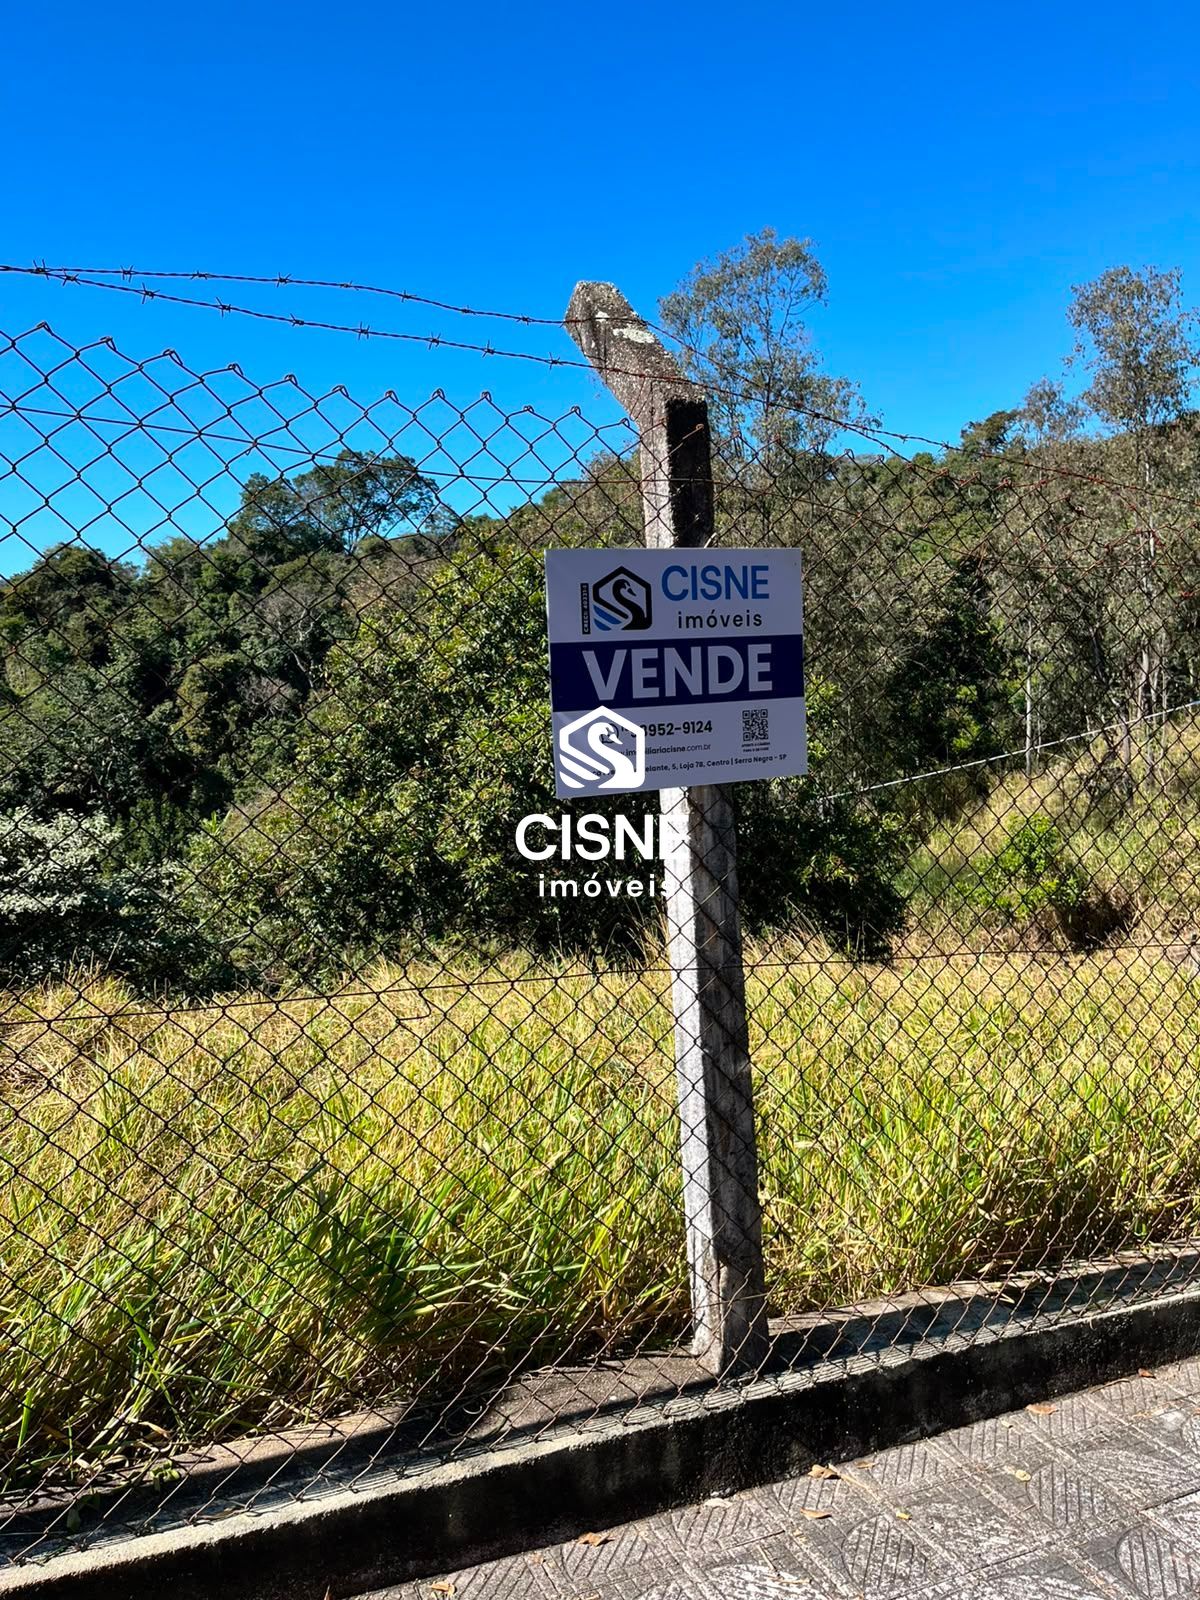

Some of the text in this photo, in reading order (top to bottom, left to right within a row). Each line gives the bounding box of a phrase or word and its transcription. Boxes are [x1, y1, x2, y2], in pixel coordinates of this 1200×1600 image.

[661, 565, 769, 601] CISNE
[678, 609, 763, 629] imóveis
[582, 643, 773, 701] VENDE
[679, 762, 694, 771] Loja
[706, 758, 730, 767] Centro
[753, 755, 774, 764] Negra
[778, 753, 788, 761] SP
